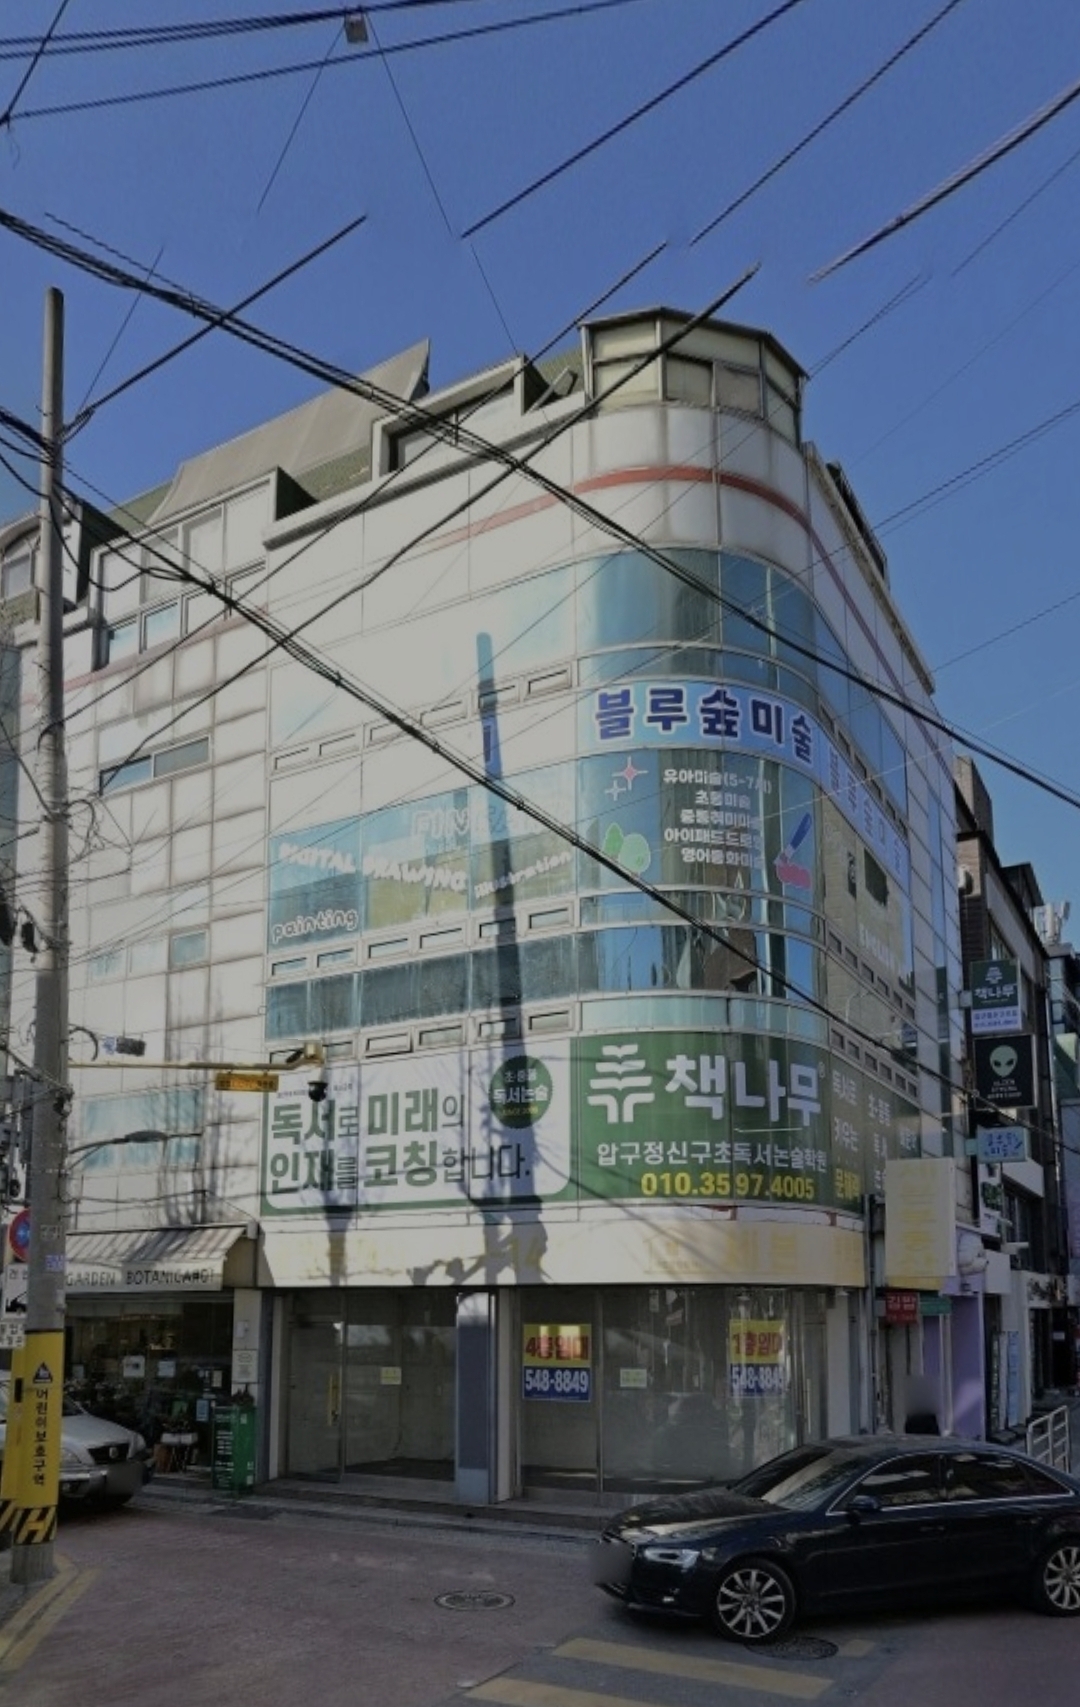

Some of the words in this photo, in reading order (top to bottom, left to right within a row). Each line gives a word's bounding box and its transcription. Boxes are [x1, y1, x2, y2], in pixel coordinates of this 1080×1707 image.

[596, 687, 813, 763] 블루숲미술
[363, 855, 468, 893] DRAWING
[272, 907, 358, 943] painting
[493, 1084, 548, 1104] 독서논술
[665, 1054, 821, 1127] 책나무
[271, 1099, 359, 1145] 독서로
[368, 1088, 465, 1136] 미래의
[270, 1149, 358, 1194] 인재를
[364, 1141, 531, 1188] 코칭합니다.
[642, 1172, 815, 1199] 010.3597.4005
[525, 1369, 589, 1393] 548-8849
[33, 1389, 48, 1486] 어린이보호구역
